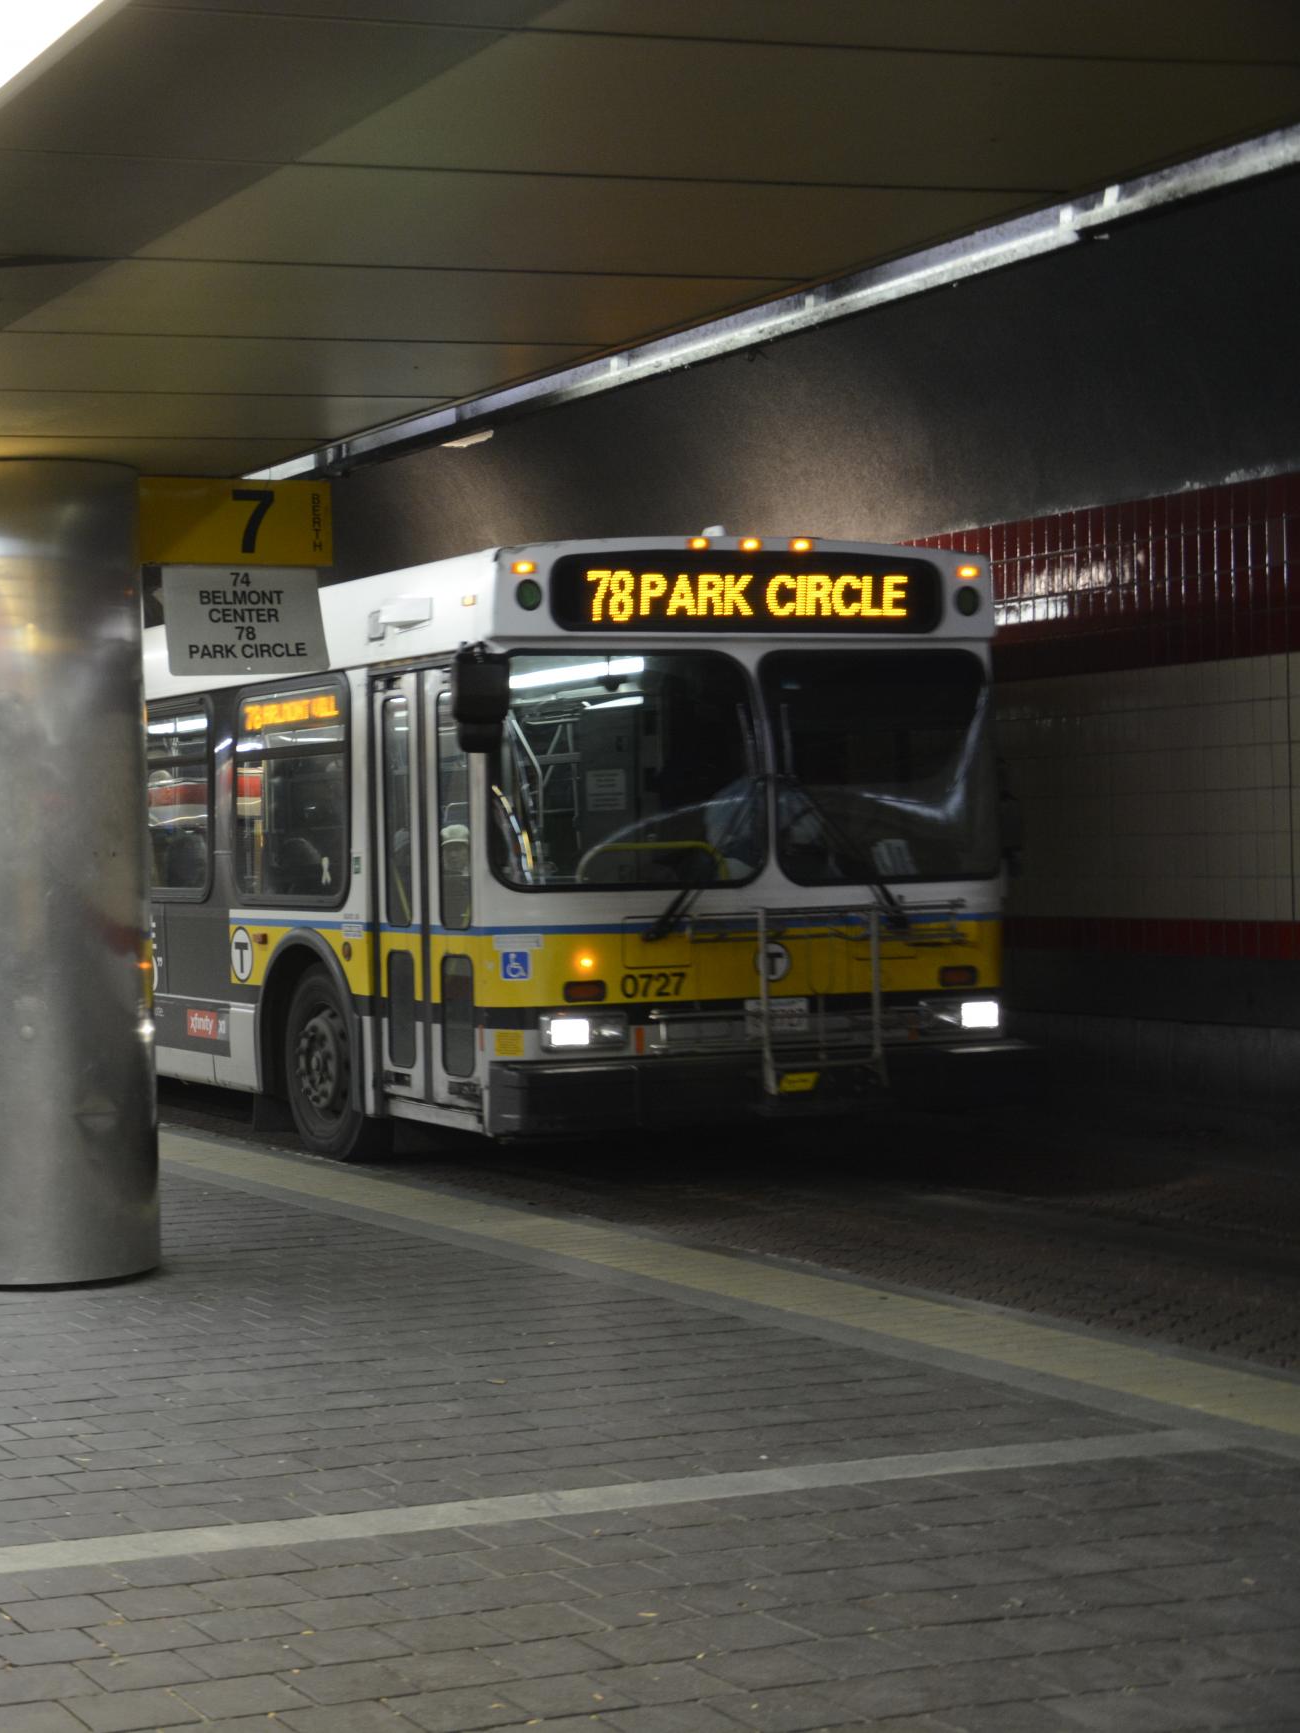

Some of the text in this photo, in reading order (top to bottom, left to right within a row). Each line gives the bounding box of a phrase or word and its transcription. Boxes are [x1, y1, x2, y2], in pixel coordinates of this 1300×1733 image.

[232, 490, 274, 553] 7
[311, 494, 322, 551] BERTH
[230, 572, 251, 587] 74
[199, 590, 284, 605] BELMONT
[586, 570, 909, 622] 78 PARK CIRCLE
[208, 608, 280, 623] CENTER
[235, 626, 256, 641] 78
[189, 642, 307, 659] PARK CIRCLE
[235, 942, 248, 973] T
[621, 972, 687, 999] 0727
[190, 1013, 213, 1034] xfinity
